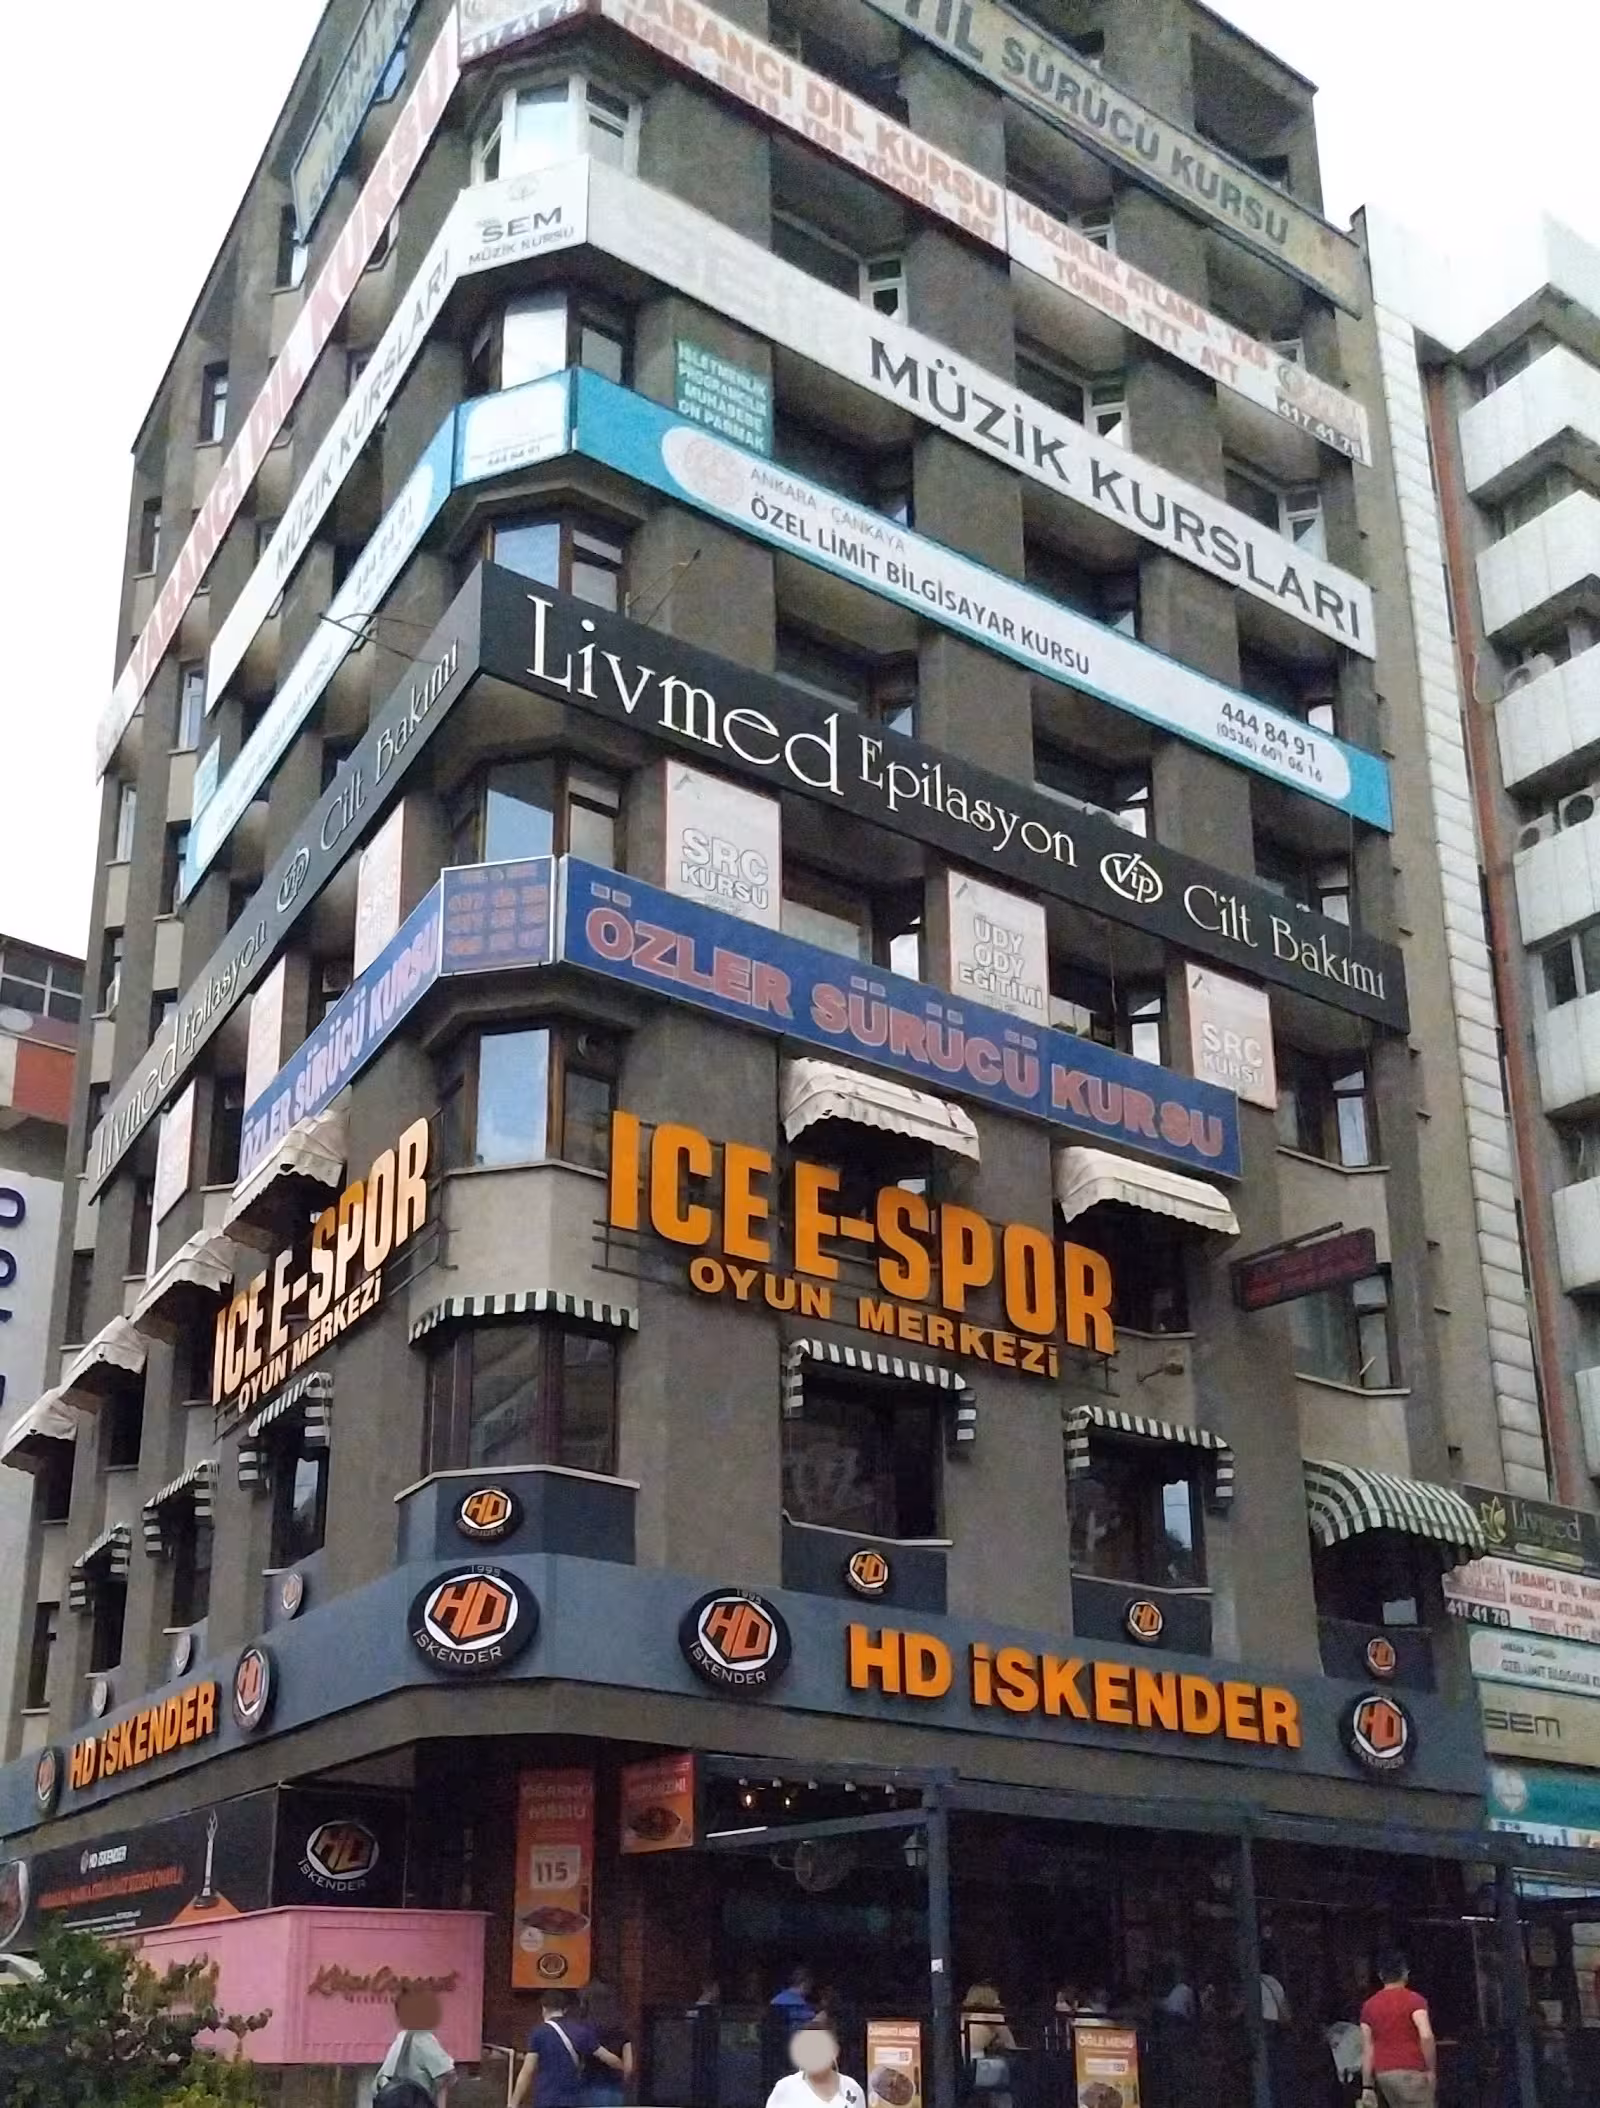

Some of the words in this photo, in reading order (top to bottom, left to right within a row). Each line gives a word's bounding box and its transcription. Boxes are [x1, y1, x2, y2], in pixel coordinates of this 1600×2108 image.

[640, 0, 794, 97] ABANCI
[875, 121, 998, 219] KURSU
[1001, 35, 1161, 163] SÜRÜCÜ
[1170, 143, 1290, 247] KURSU
[481, 205, 562, 244] SEM
[520, 226, 574, 250] KURSU
[339, 248, 450, 462] KURSLARI
[750, 467, 817, 511] ANKARA
[869, 335, 1072, 486] MÜZİK
[1088, 457, 1362, 642] KURSLARI
[750, 491, 812, 543] ÖZEL
[818, 525, 880, 575] LİMİT
[886, 558, 1016, 643] BİLGİSAYAR
[1020, 624, 1090, 676] KURSU
[1220, 702, 1260, 733] 444
[1264, 721, 1289, 749] 84
[1294, 736, 1316, 763] 91
[526, 593, 846, 798] Livmed
[857, 733, 1079, 869] Epilasyon
[1183, 884, 1259, 949] Cilt
[1269, 914, 1387, 1001] Bakımı
[680, 860, 769, 911] KURSU
[681, 827, 769, 886] SRC
[97, 1011, 181, 1184] Livmed
[180, 919, 268, 1057] Epilasyon
[320, 768, 368, 852] Cilt
[374, 636, 460, 788] Bakımı
[293, 984, 368, 1121] SÜRÜCÜ
[368, 910, 440, 1041] KURSU
[585, 881, 794, 1020] ÖZLER
[810, 975, 1041, 1099] SÜRÜCÜ
[1050, 1063, 1224, 1158] KURSU
[1201, 1021, 1264, 1069] SRC
[1202, 1052, 1265, 1087] KURSU
[211, 1268, 268, 1407] ICE
[269, 1116, 429, 1357] E-SPOR
[609, 1109, 773, 1264] ICE
[794, 1160, 1116, 1357] E-SPOR
[688, 1256, 833, 1320] OYUN
[237, 1351, 289, 1414] OYUN
[465, 1491, 507, 1527] HD
[470, 1564, 501, 1577] 1995
[433, 1580, 508, 1640] HD
[704, 1602, 771, 1660] HD
[849, 1624, 953, 1699] HD
[1359, 1702, 1403, 1750] HD
[70, 1736, 97, 1790] HD
[535, 1861, 568, 1883] 115
